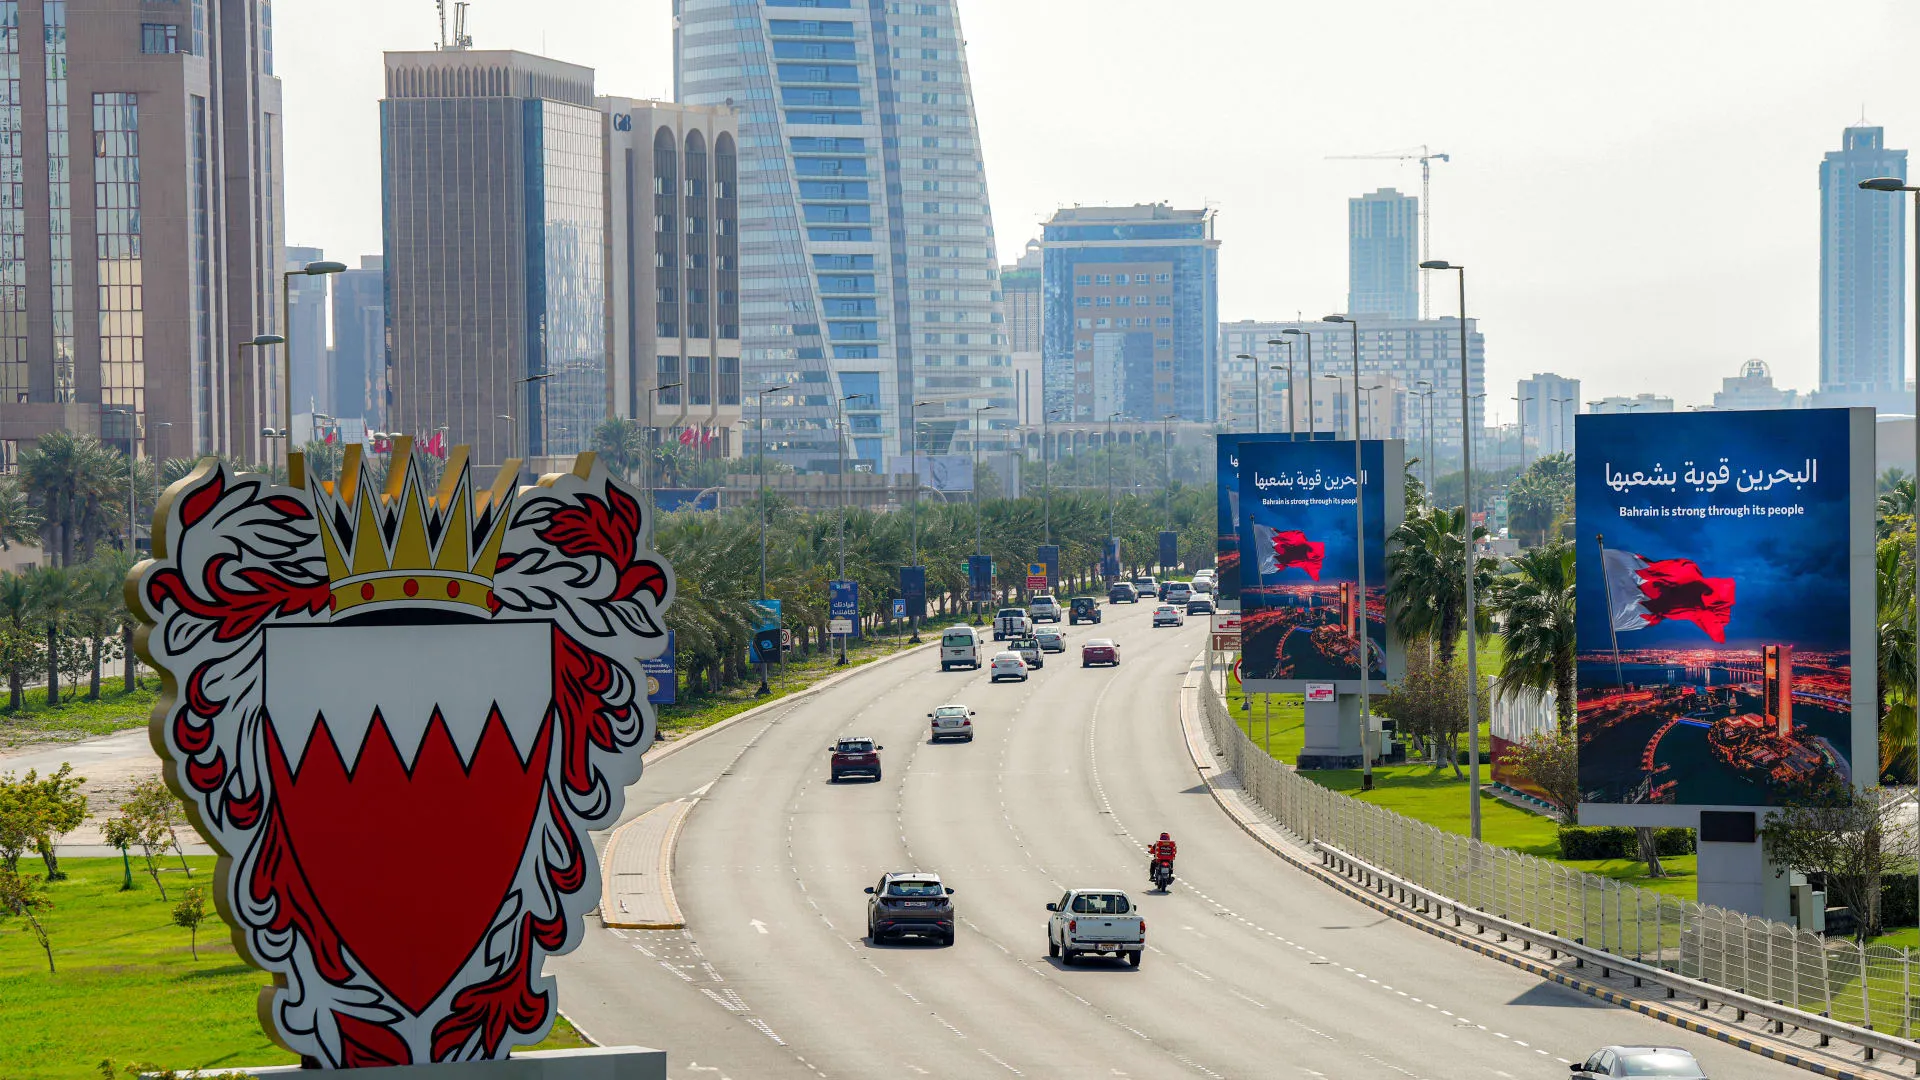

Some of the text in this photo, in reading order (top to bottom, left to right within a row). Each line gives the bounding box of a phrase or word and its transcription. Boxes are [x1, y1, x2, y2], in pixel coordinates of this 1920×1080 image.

[1254, 471, 1294, 491] بشعبها
[1296, 469, 1322, 491] قوية
[1605, 457, 1817, 494] البحرين قوية بشعبها
[1262, 498, 1284, 506] Bahrain
[1290, 498, 1309, 507] strong
[1309, 497, 1332, 507] through
[1332, 497, 1341, 505] its
[1341, 497, 1358, 507] peopl
[1619, 503, 1804, 519] Bahrain is strong through its people
